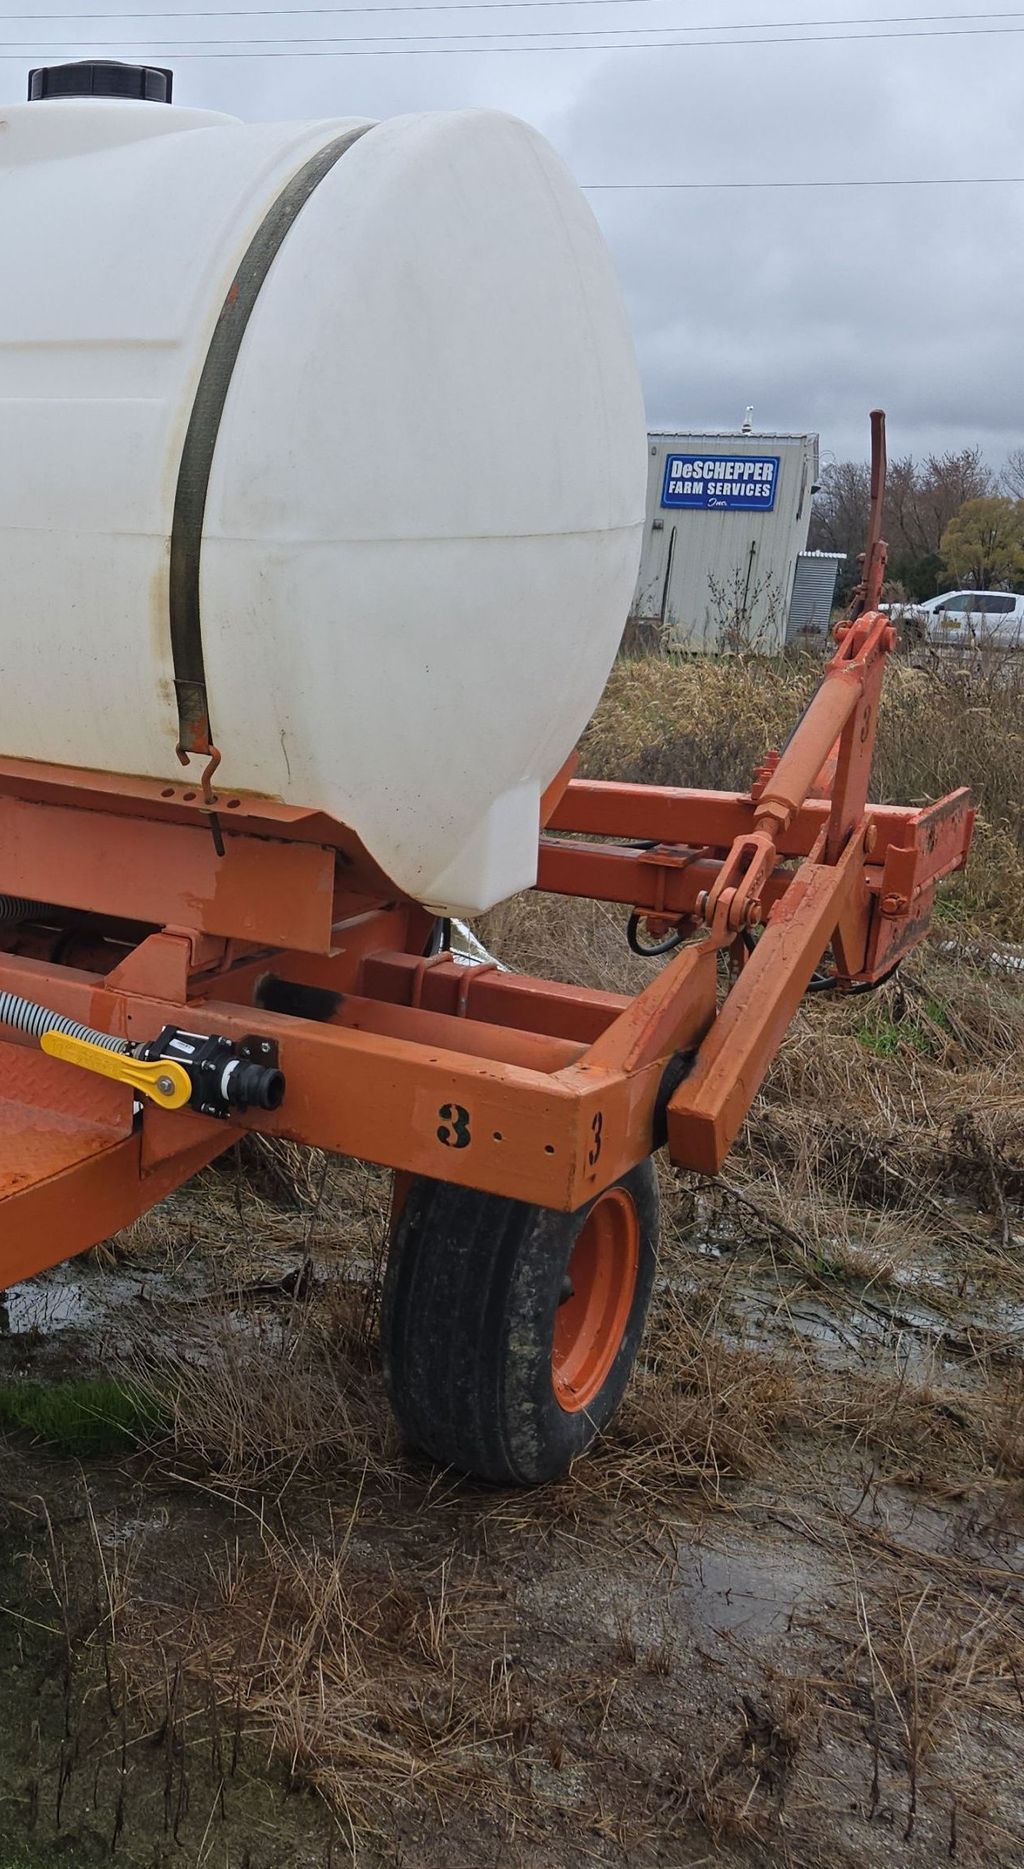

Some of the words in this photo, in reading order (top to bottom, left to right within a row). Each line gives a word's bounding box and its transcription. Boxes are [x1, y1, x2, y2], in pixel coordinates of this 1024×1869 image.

[671, 460, 774, 481] DeSCHEPPER
[668, 481, 703, 495] FARM
[707, 482, 771, 497] SERVICES
[437, 1103, 472, 1149] 3
[589, 1111, 603, 1167] 3
